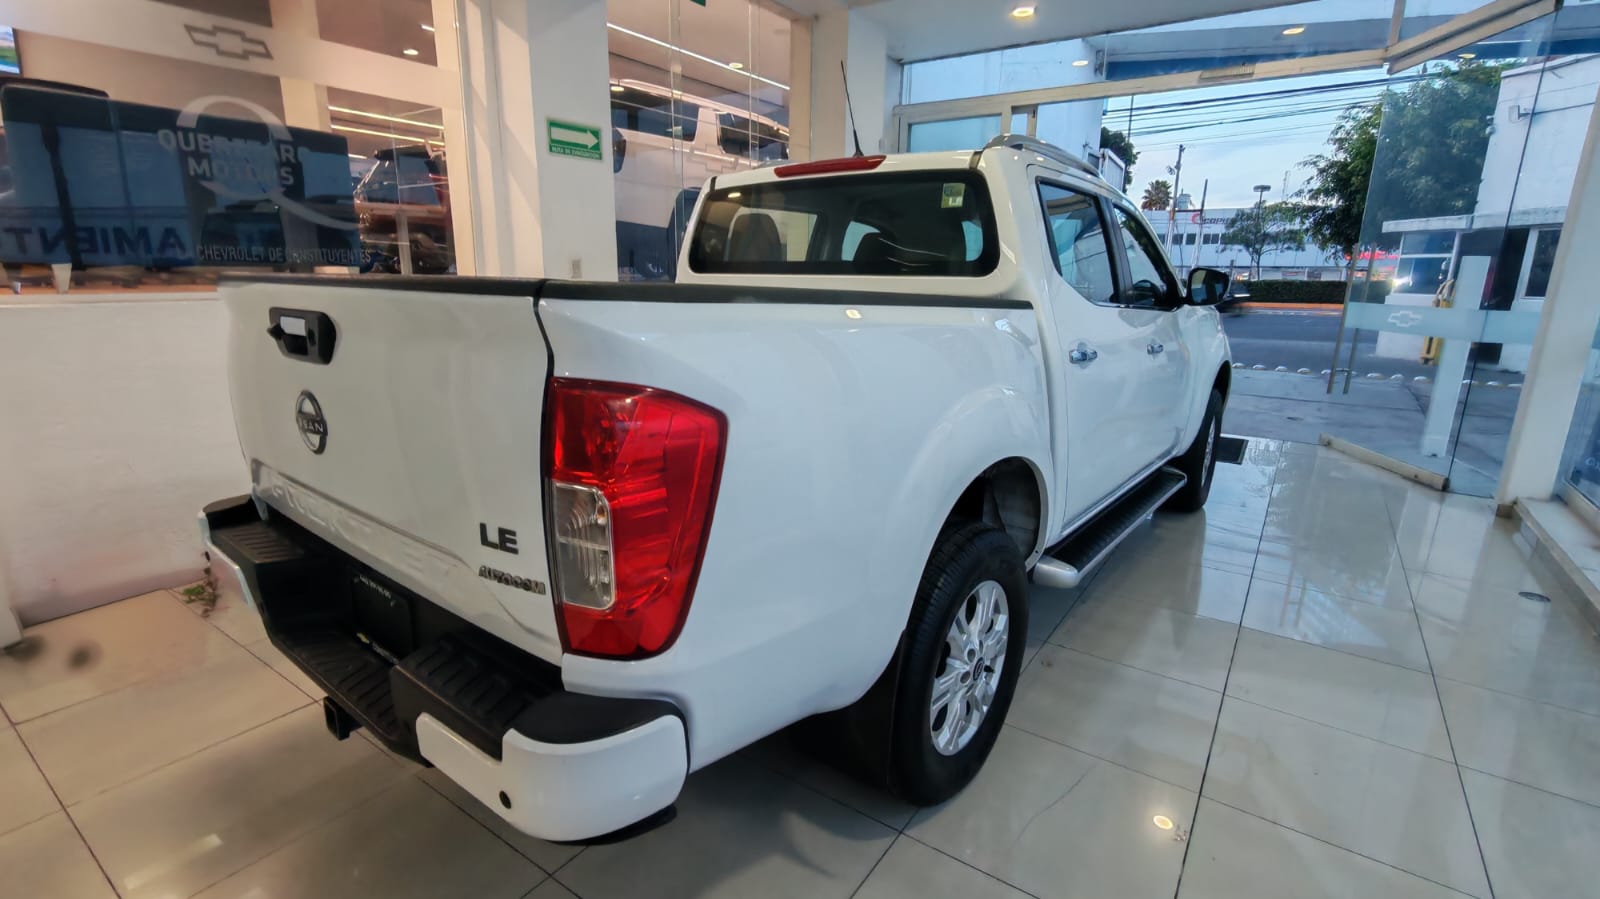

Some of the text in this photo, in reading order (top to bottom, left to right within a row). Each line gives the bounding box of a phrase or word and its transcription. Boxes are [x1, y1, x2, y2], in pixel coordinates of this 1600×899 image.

[196, 245, 265, 261] CHEVROLET
[268, 247, 284, 262] DE
[479, 522, 519, 555] LE
